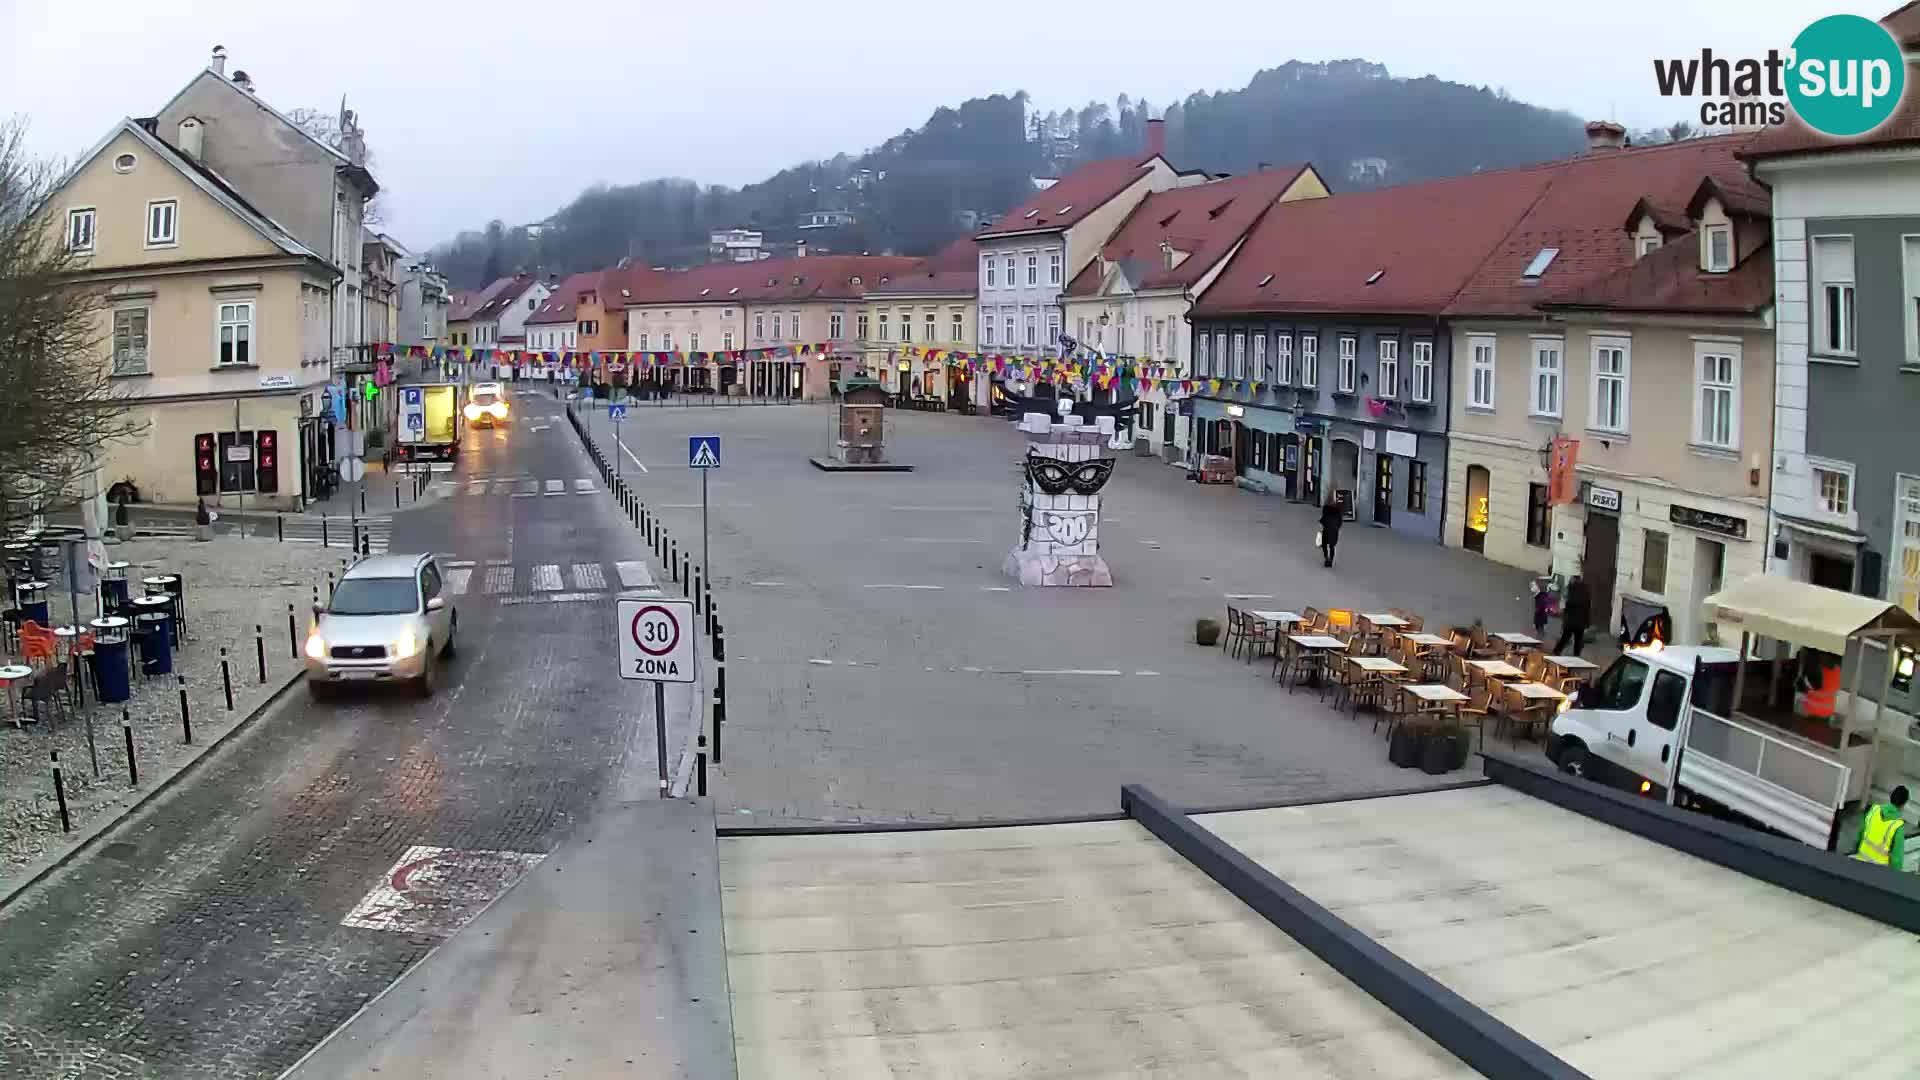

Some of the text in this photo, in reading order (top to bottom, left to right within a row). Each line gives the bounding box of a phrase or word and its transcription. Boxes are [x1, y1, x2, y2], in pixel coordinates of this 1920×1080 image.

[409, 391, 417, 402] P
[1048, 515, 1087, 544] 200
[644, 621, 668, 642] 30
[635, 658, 679, 675] ZONA
